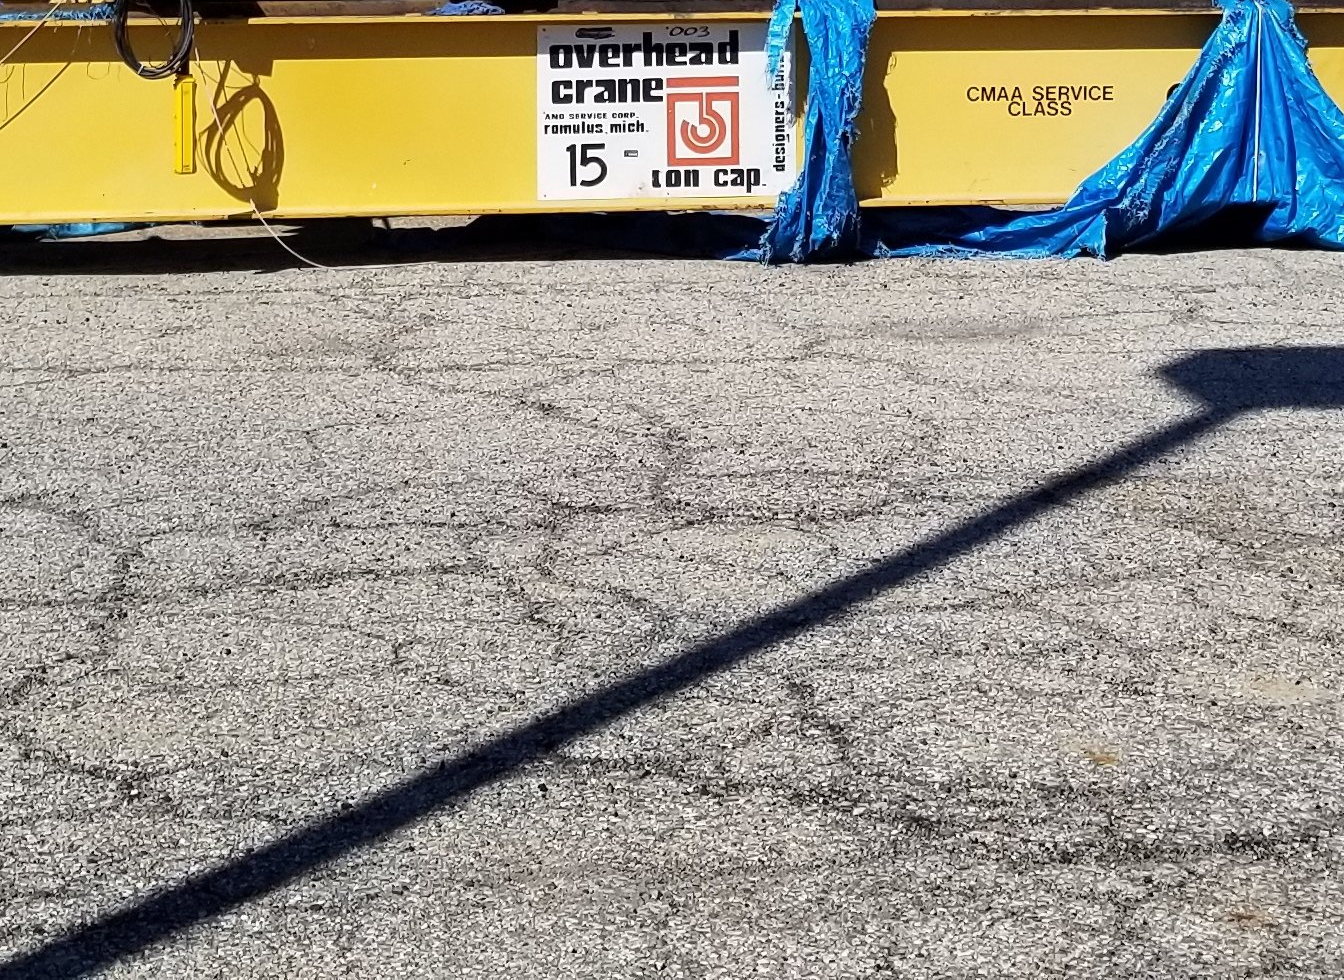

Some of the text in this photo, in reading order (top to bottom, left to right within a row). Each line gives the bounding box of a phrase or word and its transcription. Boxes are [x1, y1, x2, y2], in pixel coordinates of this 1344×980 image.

[549, 30, 739, 69] overhead
[551, 77, 663, 104] crane
[966, 85, 1114, 102] CMAA SERVICE
[568, 112, 608, 120] SERVICE
[611, 111, 640, 119] CORP.
[1007, 101, 1072, 116] CLASS
[610, 120, 649, 133] mich.
[565, 142, 608, 187] 15
[651, 167, 767, 193] ton cap.
